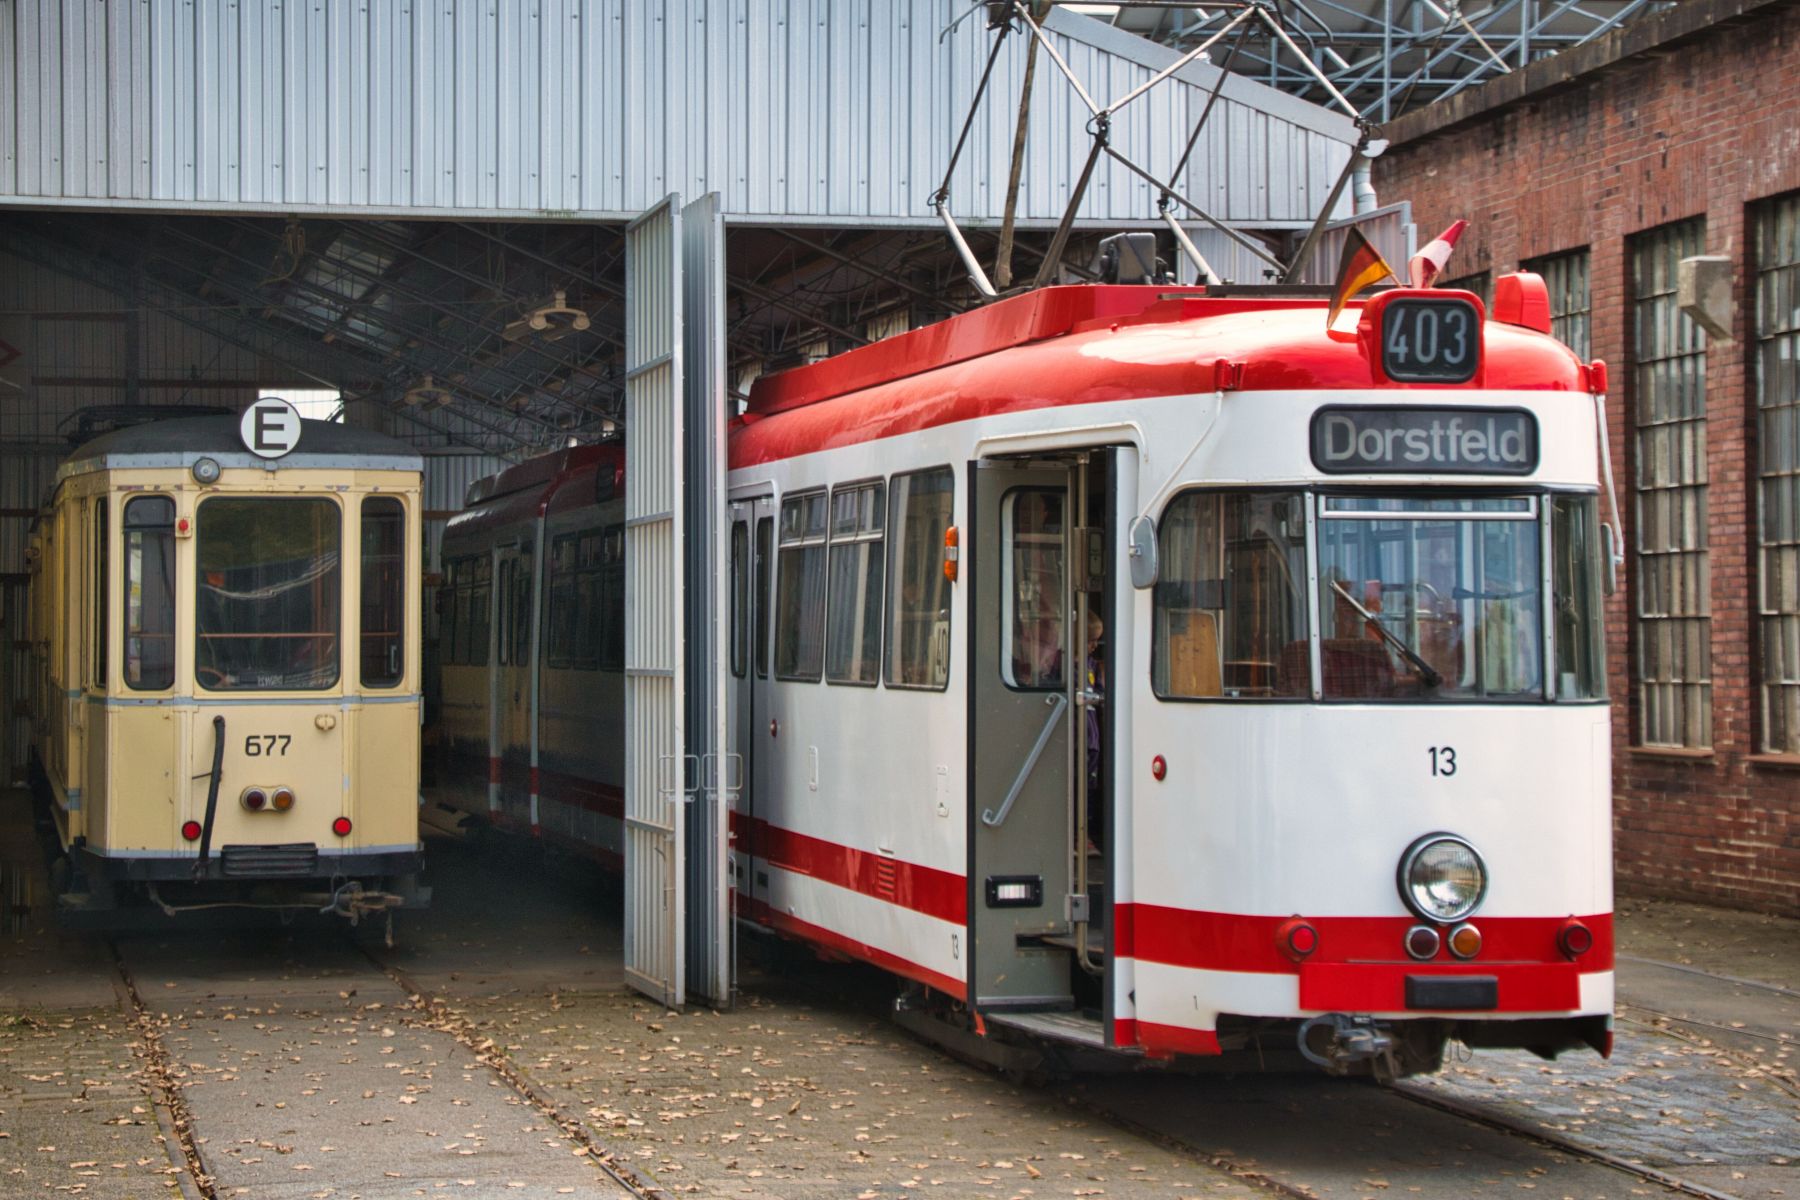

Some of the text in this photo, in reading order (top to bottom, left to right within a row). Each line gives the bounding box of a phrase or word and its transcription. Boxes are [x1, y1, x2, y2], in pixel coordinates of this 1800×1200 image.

[1388, 308, 1467, 364] 403
[254, 406, 288, 450] E
[1325, 415, 1527, 462] Dorstfeld
[245, 735, 291, 756] 677
[1428, 746, 1456, 777] 13
[951, 934, 959, 960] 13
